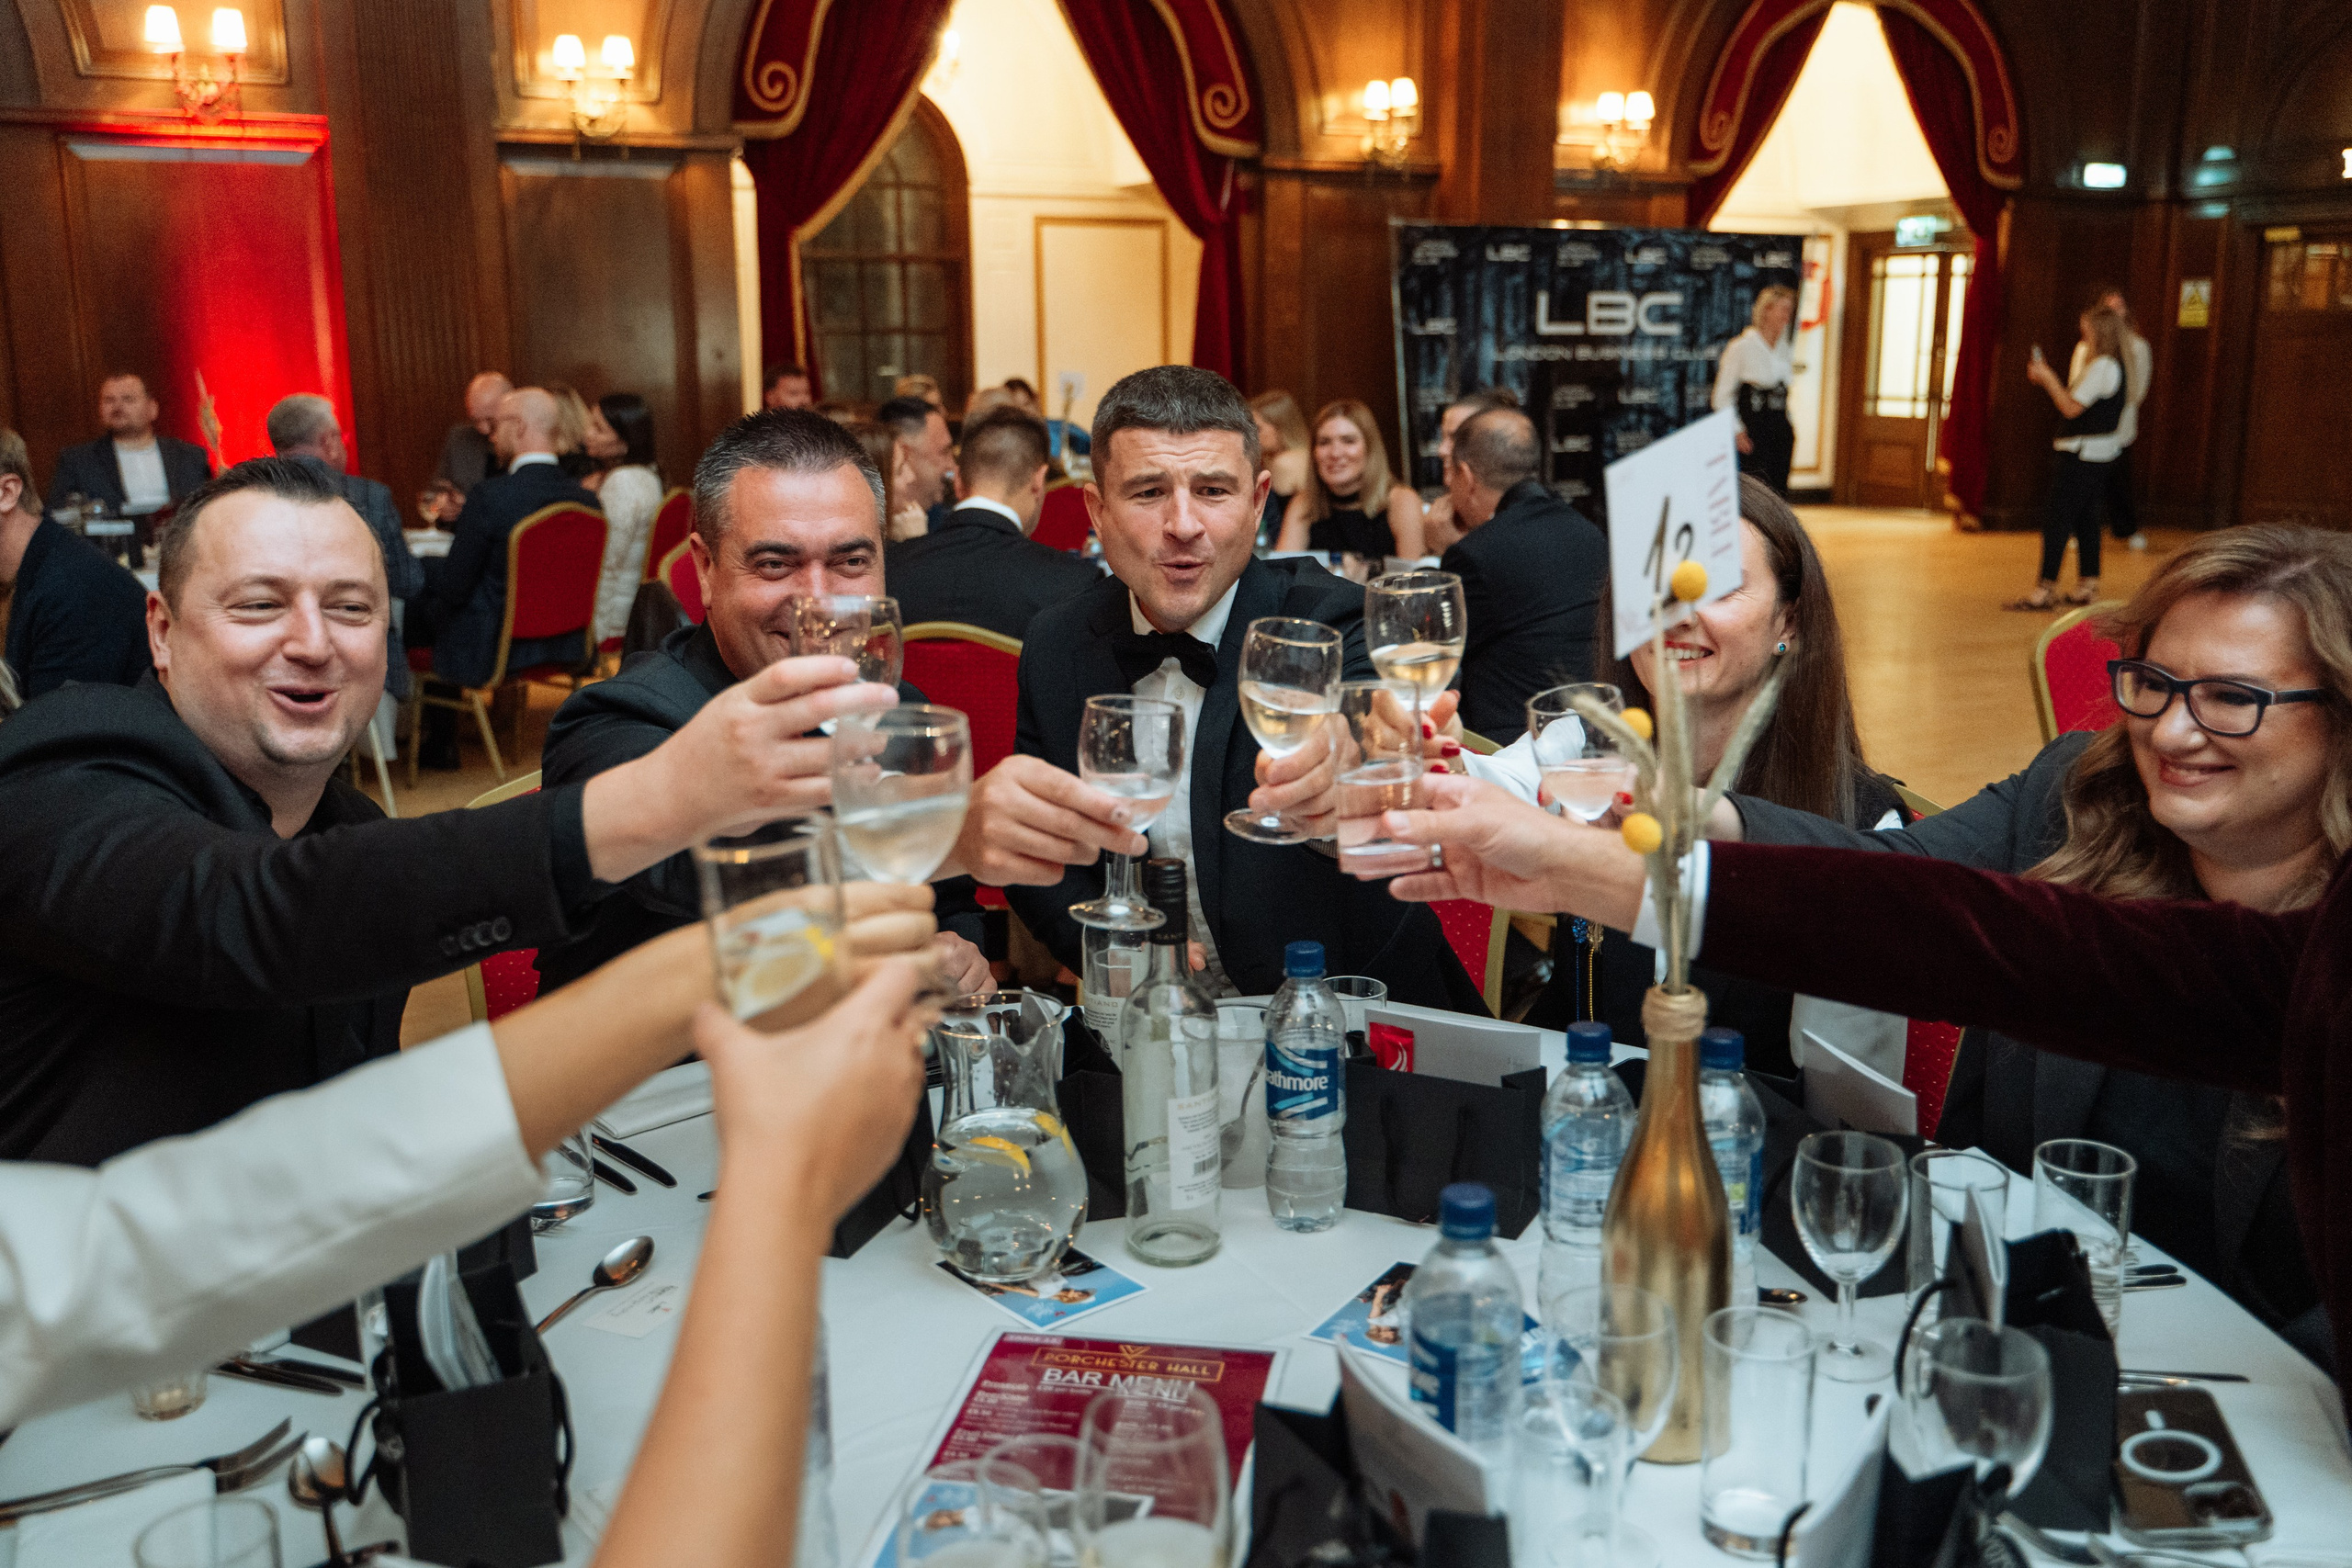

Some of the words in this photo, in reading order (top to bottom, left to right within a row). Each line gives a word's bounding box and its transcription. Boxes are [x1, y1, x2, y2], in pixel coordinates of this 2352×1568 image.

[1536, 289, 1684, 335] LBC
[1267, 1069, 1329, 1091] athmore
[1043, 1353, 1159, 1371] PORCHESTER
[1166, 1363, 1211, 1376] HALL
[1042, 1368, 1103, 1386] BAR
[1109, 1374, 1196, 1400] MENU
